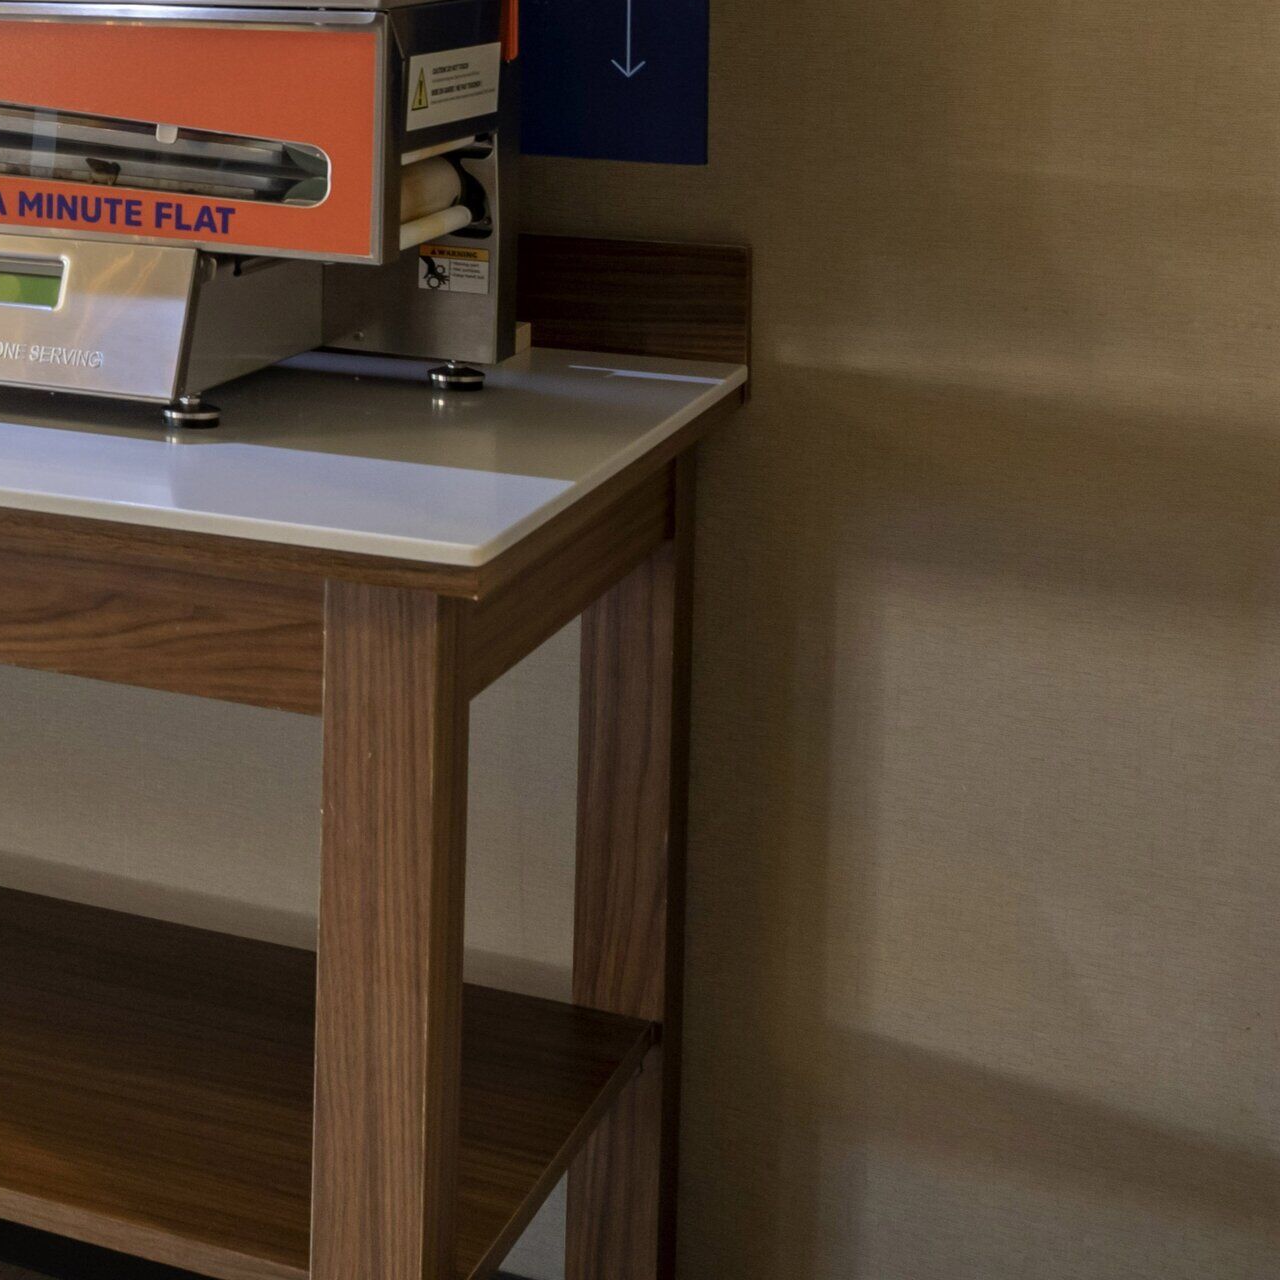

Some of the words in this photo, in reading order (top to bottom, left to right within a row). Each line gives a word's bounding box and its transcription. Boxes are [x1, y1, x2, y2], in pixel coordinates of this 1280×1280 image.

[18, 190, 142, 226] MINUTE
[154, 202, 236, 234] FLAT
[29, 345, 104, 368] SERVING
